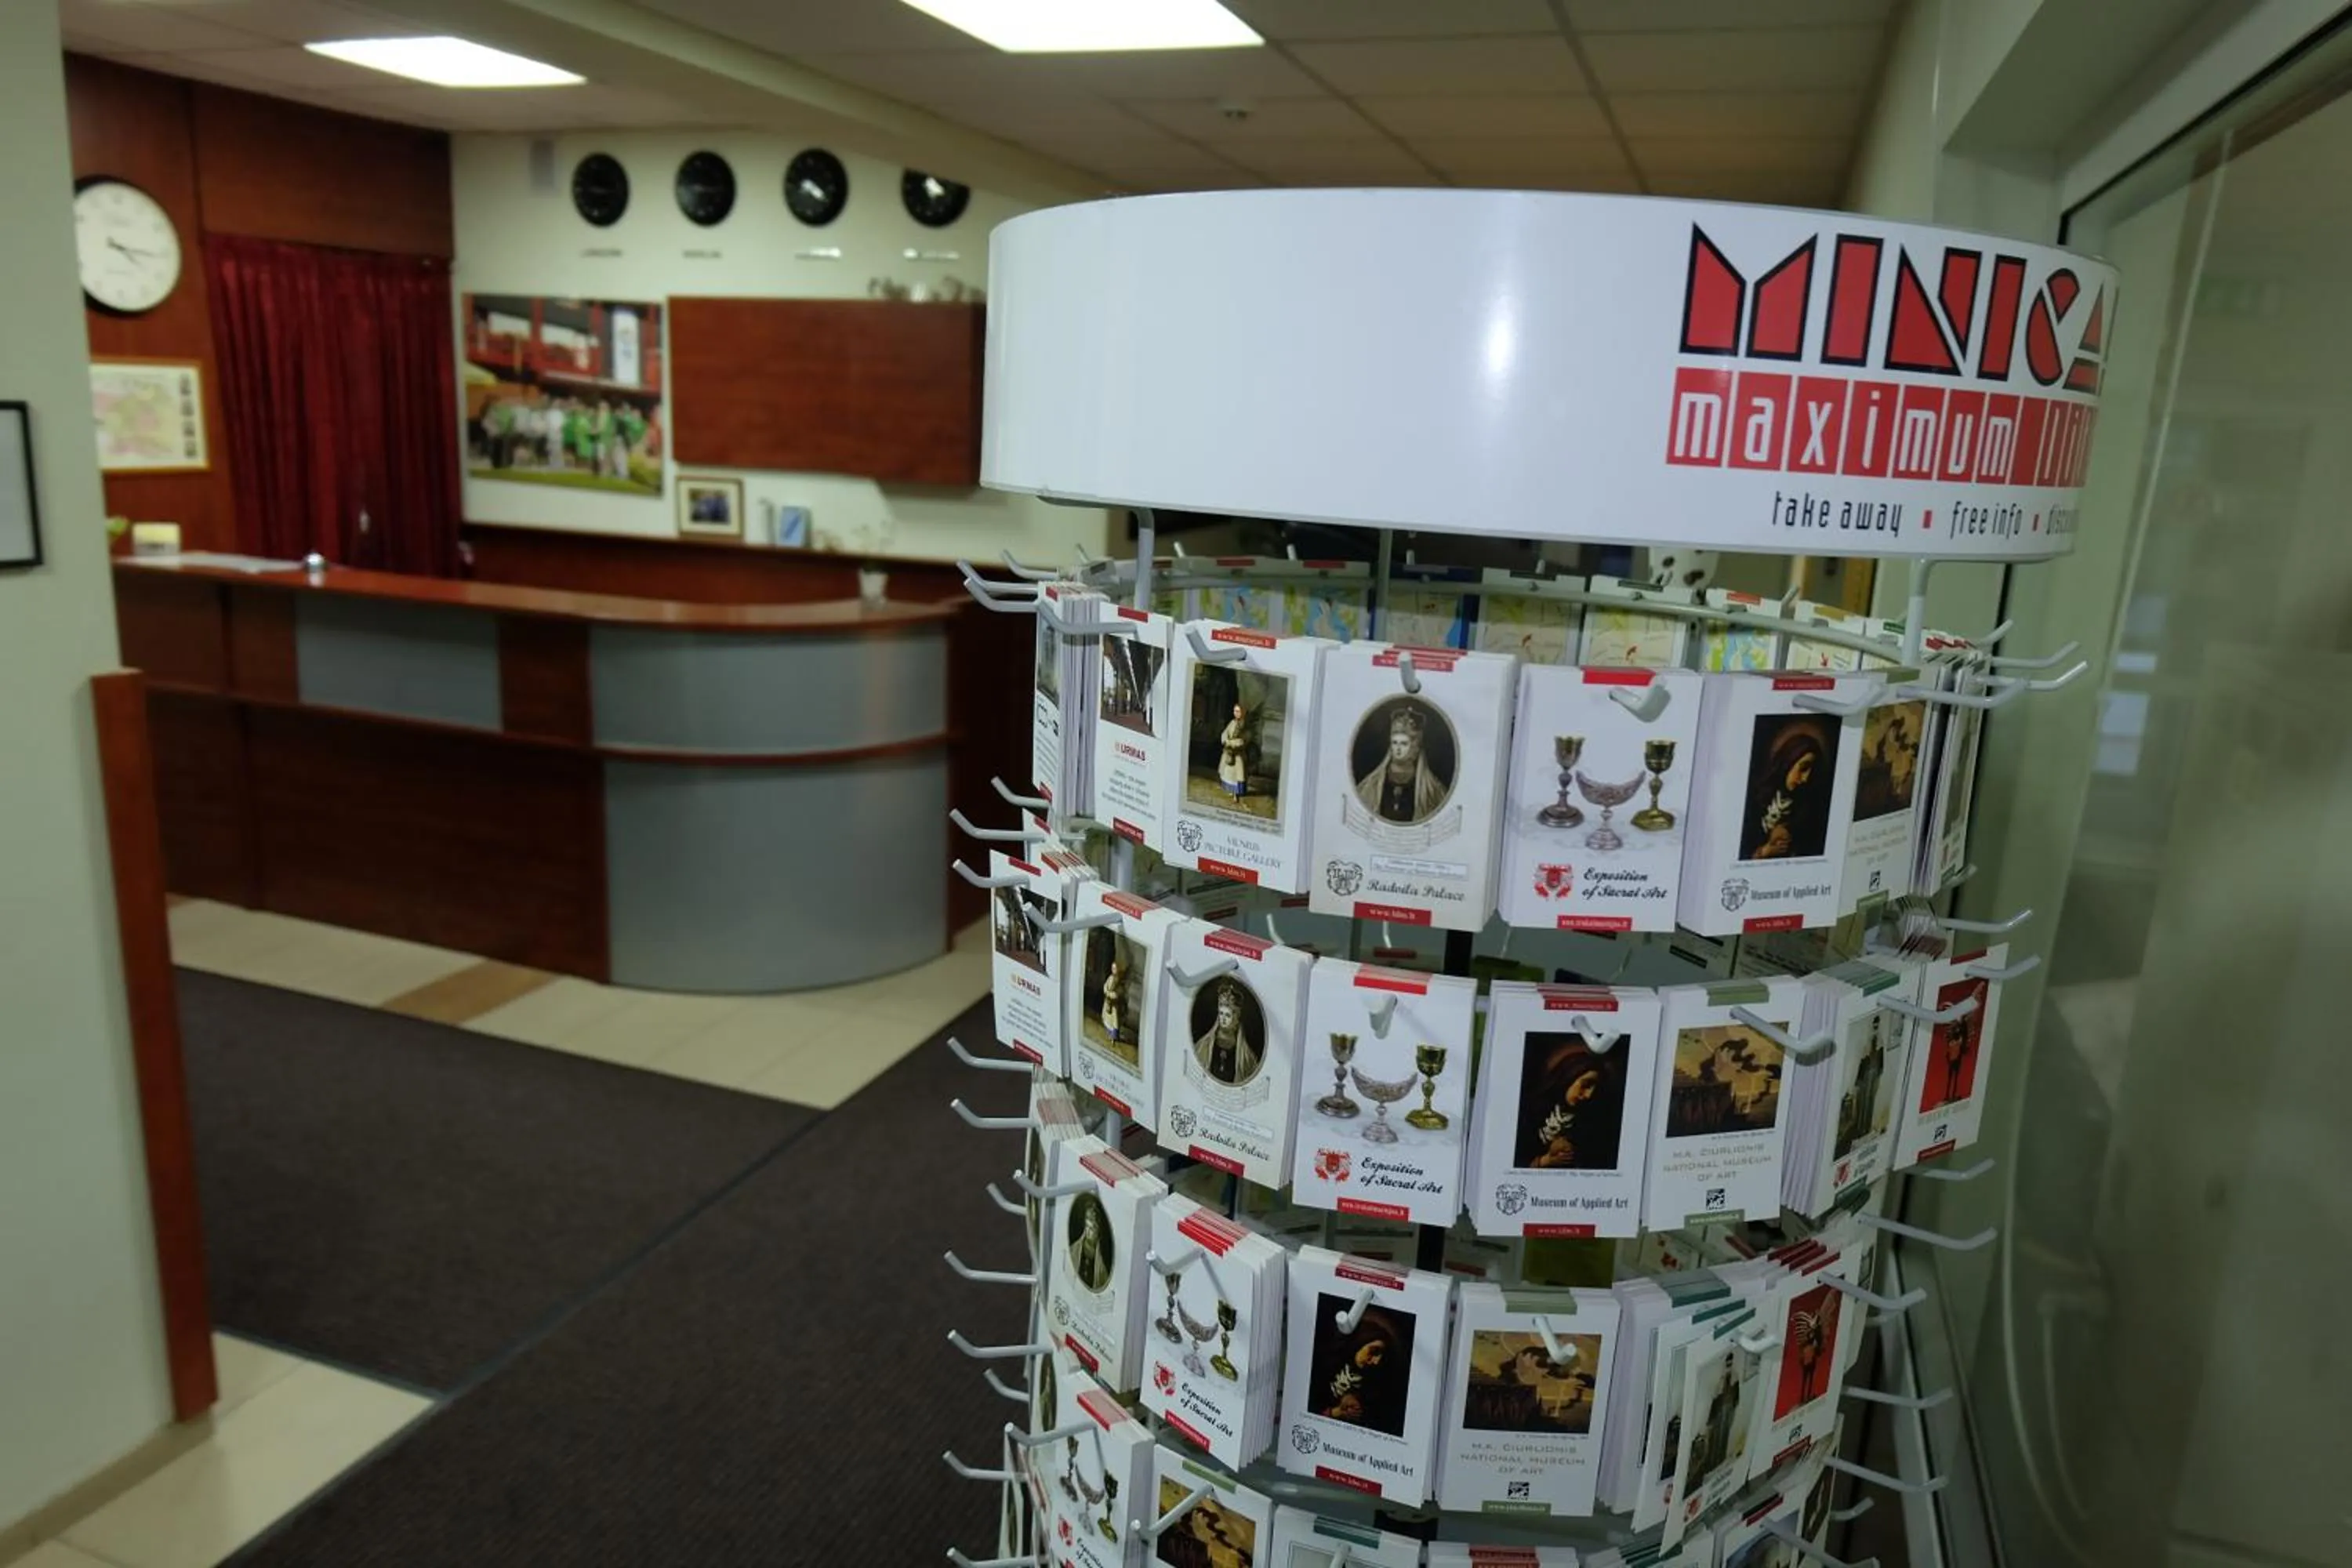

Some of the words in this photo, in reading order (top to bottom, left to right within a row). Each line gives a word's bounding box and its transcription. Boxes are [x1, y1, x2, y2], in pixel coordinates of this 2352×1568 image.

[1671, 386, 2015, 480] maximum
[1772, 490, 1831, 529] take
[1839, 500, 1903, 538] away
[1950, 499, 1987, 539] free
[1992, 503, 2024, 540] info
[1583, 866, 1648, 884] Exposition
[1421, 885, 1465, 903] Palace
[1581, 885, 1599, 900] of
[1598, 885, 1641, 898] Sacral
[1641, 886, 1668, 899] Art
[1361, 1156, 1424, 1176] Exposition
[1359, 1174, 1376, 1187] of
[1374, 1175, 1417, 1190] Sacral
[1417, 1181, 1443, 1194] Art
[1530, 1196, 1568, 1208] Museum
[1569, 1197, 1578, 1208] of
[1581, 1196, 1613, 1211] Applied
[1615, 1197, 1629, 1209] Art
[1181, 1381, 1222, 1416] Exposition
[1323, 1442, 1356, 1460] Museum
[1357, 1454, 1367, 1463] of
[1370, 1454, 1399, 1472] Applied
[1400, 1465, 1414, 1478] Art
[1459, 1453, 1523, 1465] NATIONAL
